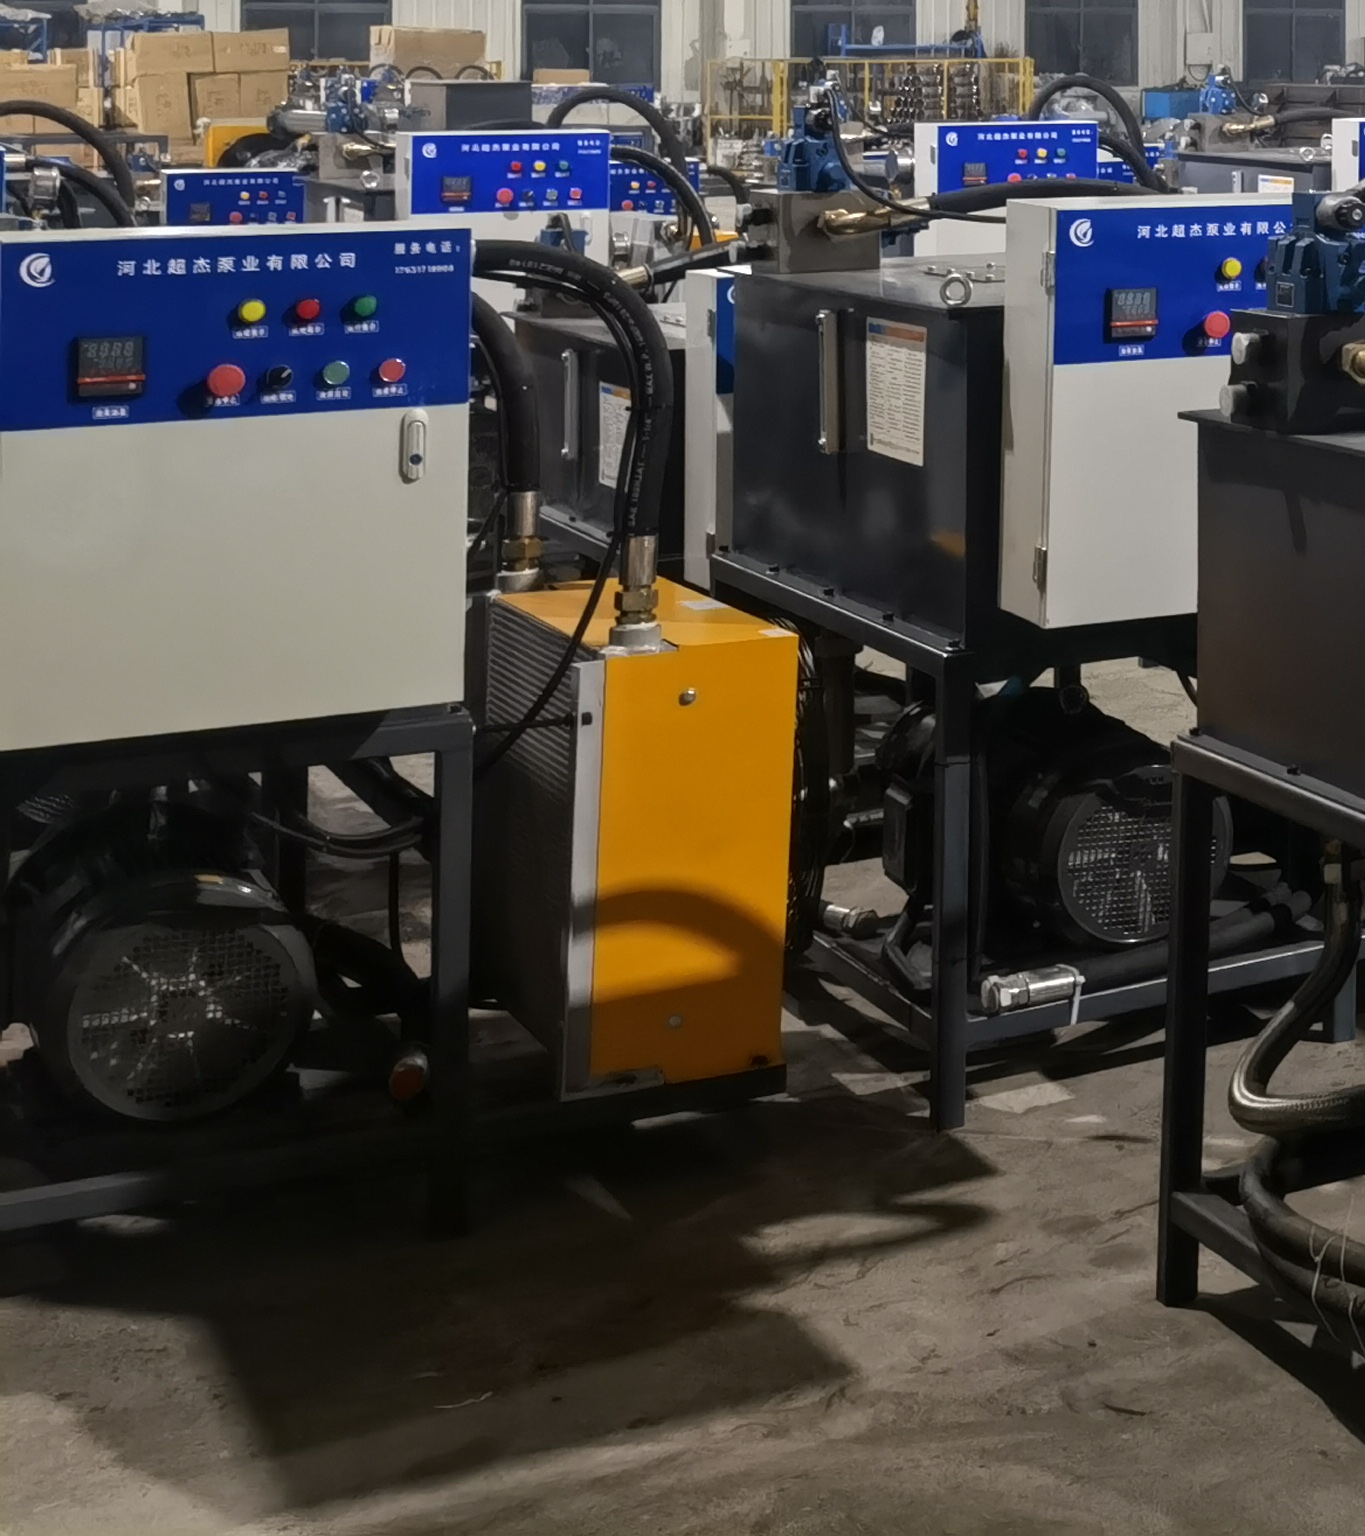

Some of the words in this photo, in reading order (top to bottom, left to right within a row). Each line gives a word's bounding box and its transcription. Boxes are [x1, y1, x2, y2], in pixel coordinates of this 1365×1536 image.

[1137, 220, 1292, 239] 河北超杰泵业有限公
[117, 252, 357, 277] 河北超杰泵业有限公司
